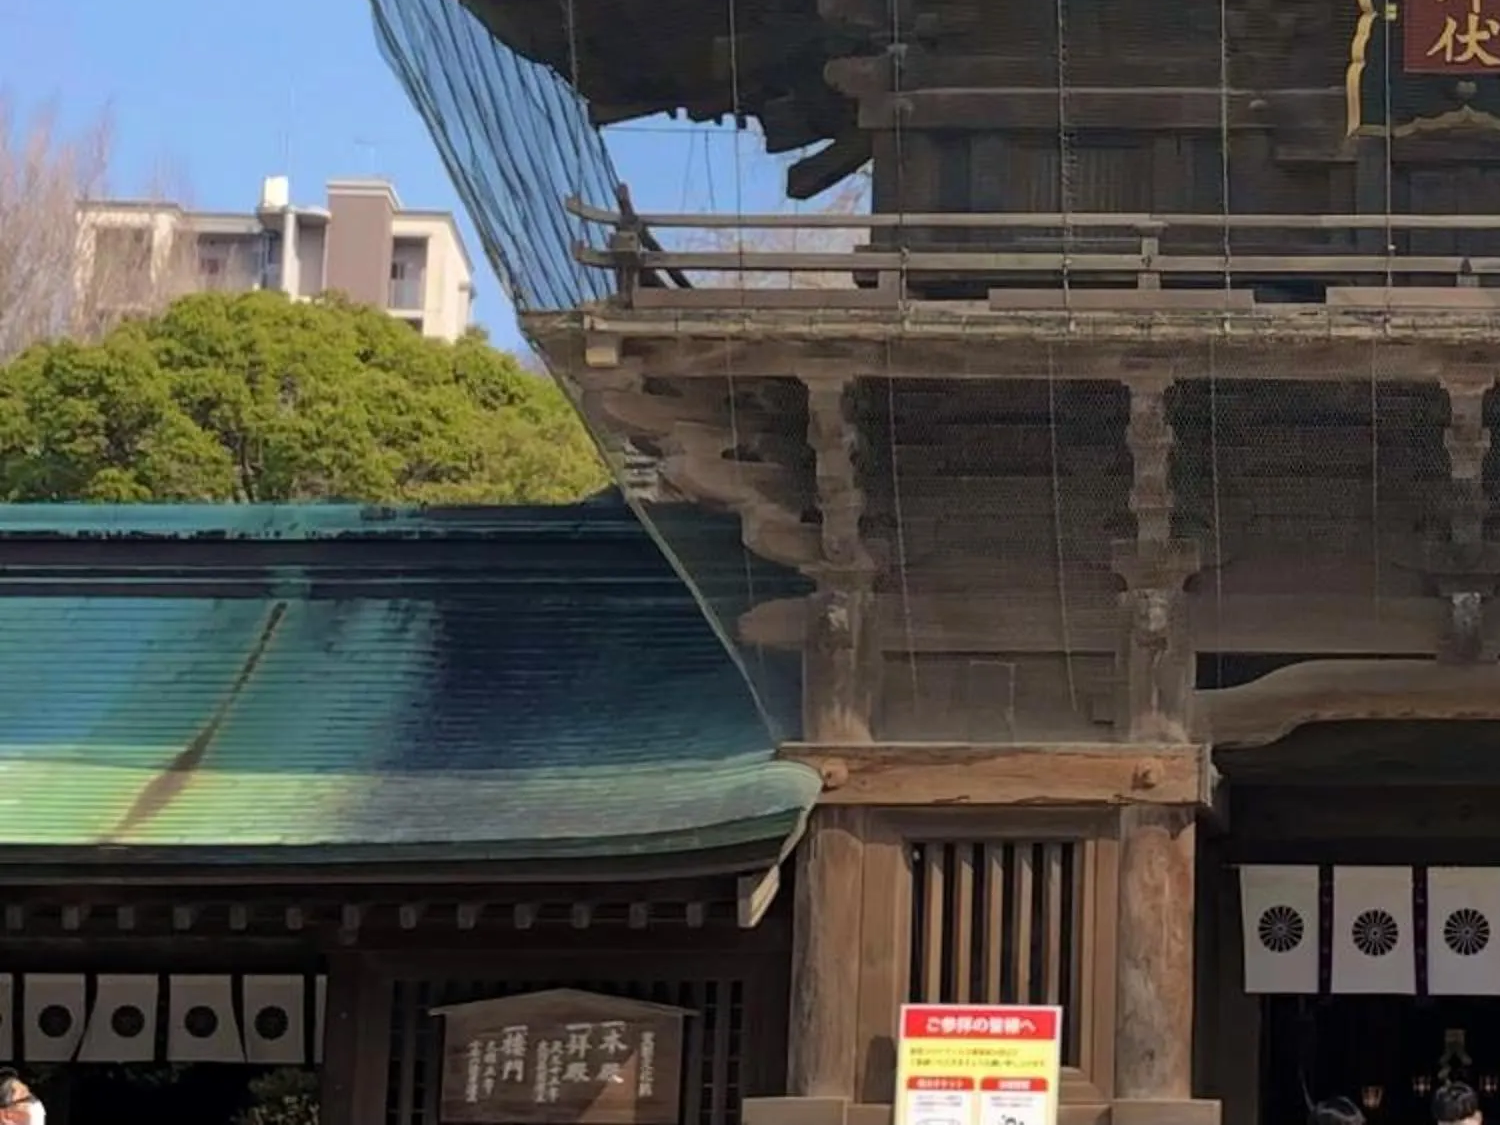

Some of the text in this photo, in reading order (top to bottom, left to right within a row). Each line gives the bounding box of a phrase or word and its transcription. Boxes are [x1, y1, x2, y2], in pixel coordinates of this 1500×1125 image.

[926, 1016, 1037, 1035] ご参拝の皆様へ
